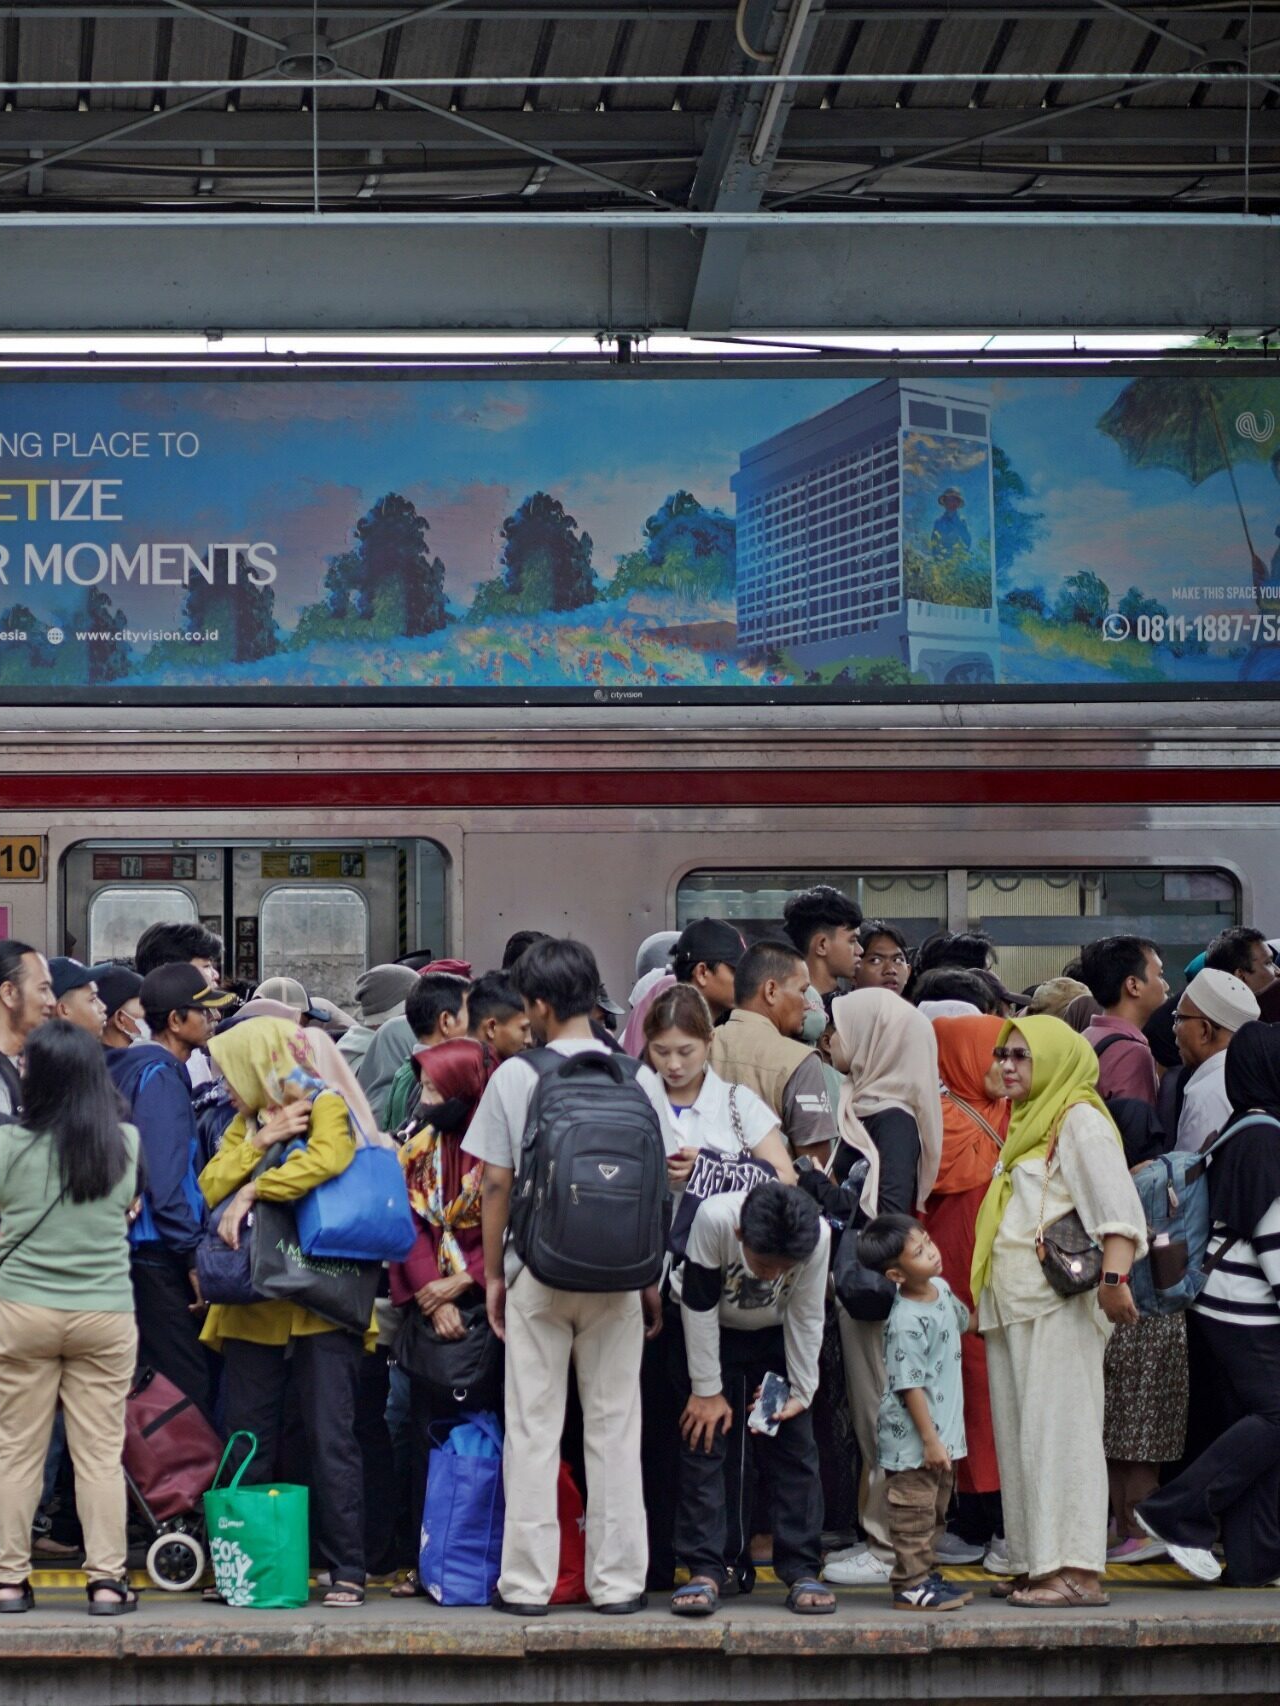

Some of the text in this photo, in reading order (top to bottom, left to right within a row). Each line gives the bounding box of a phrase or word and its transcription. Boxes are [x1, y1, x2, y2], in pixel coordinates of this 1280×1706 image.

[53, 432, 150, 458] PLACE
[158, 432, 200, 458] TO
[24, 542, 277, 586] MOMENTS
[1172, 587, 1200, 600] MAKE
[1203, 587, 1224, 600] THIS
[1226, 587, 1258, 600] SPACE
[75, 629, 219, 644] www.cityvision.co.id
[1136, 614, 1280, 642] 0811-1887-75
[0, 844, 36, 872] 10
